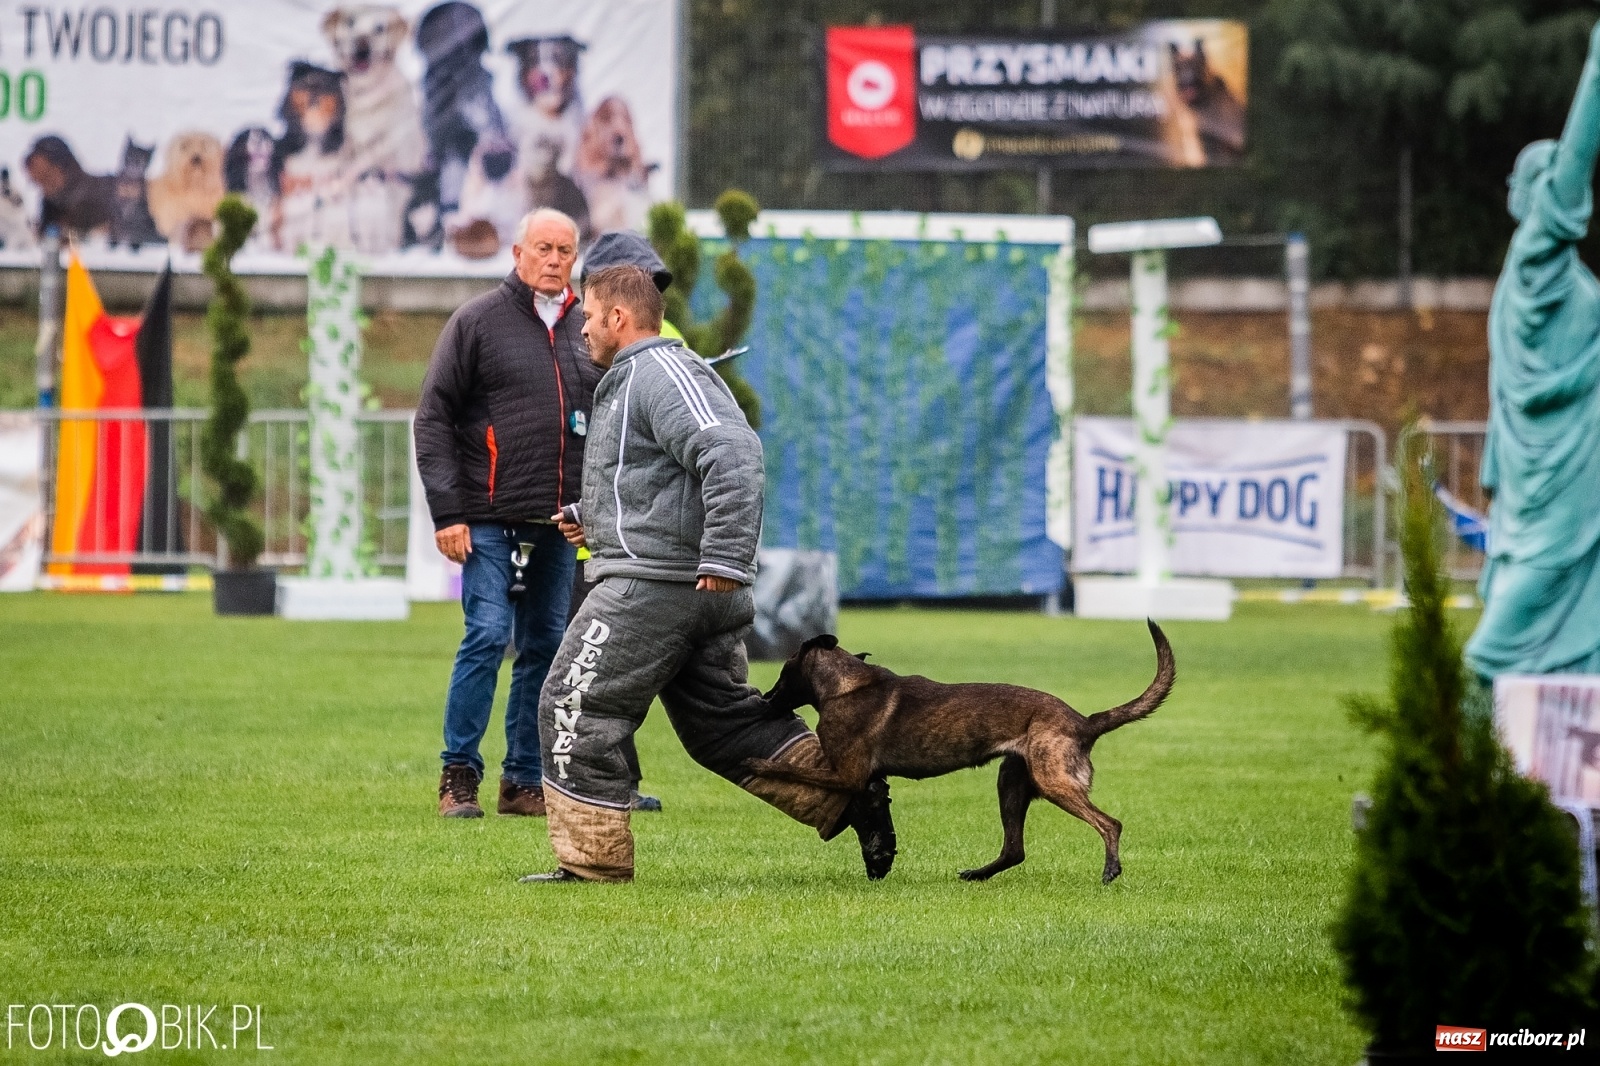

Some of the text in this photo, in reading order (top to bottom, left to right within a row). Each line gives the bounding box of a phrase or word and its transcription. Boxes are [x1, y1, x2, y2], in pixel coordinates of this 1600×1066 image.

[19, 8, 223, 65] TWOJEGO
[920, 44, 1158, 85] PRZYSMAKI
[1237, 473, 1319, 531] DOG
[551, 618, 611, 780] DEMANET
